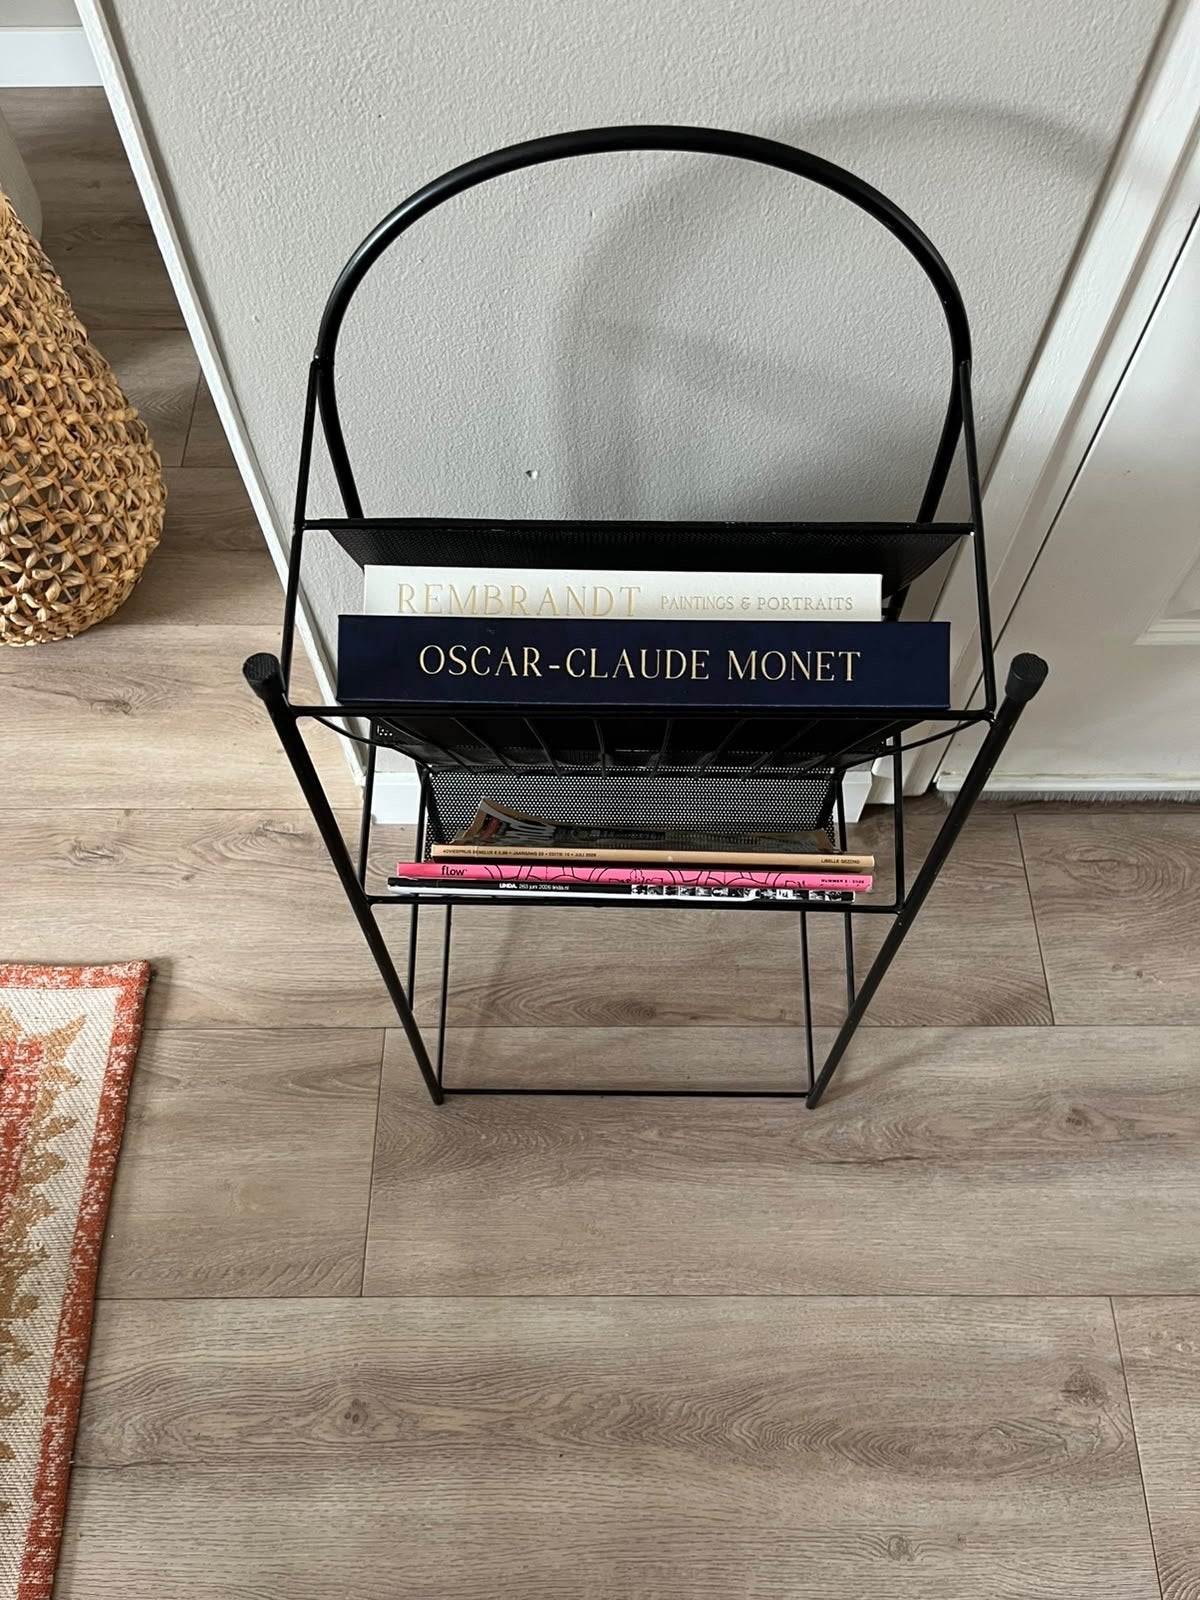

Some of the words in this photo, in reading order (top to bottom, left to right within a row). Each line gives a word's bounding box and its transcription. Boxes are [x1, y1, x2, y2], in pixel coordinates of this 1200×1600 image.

[398, 583, 642, 617] REMBRANDT
[660, 595, 735, 611] PAINTINGS
[740, 597, 752, 611] &
[757, 596, 854, 611] PORTRAITS
[419, 644, 710, 679] OSCAR-CLAUDE
[727, 649, 861, 682] MONET
[441, 864, 465, 876] flow
